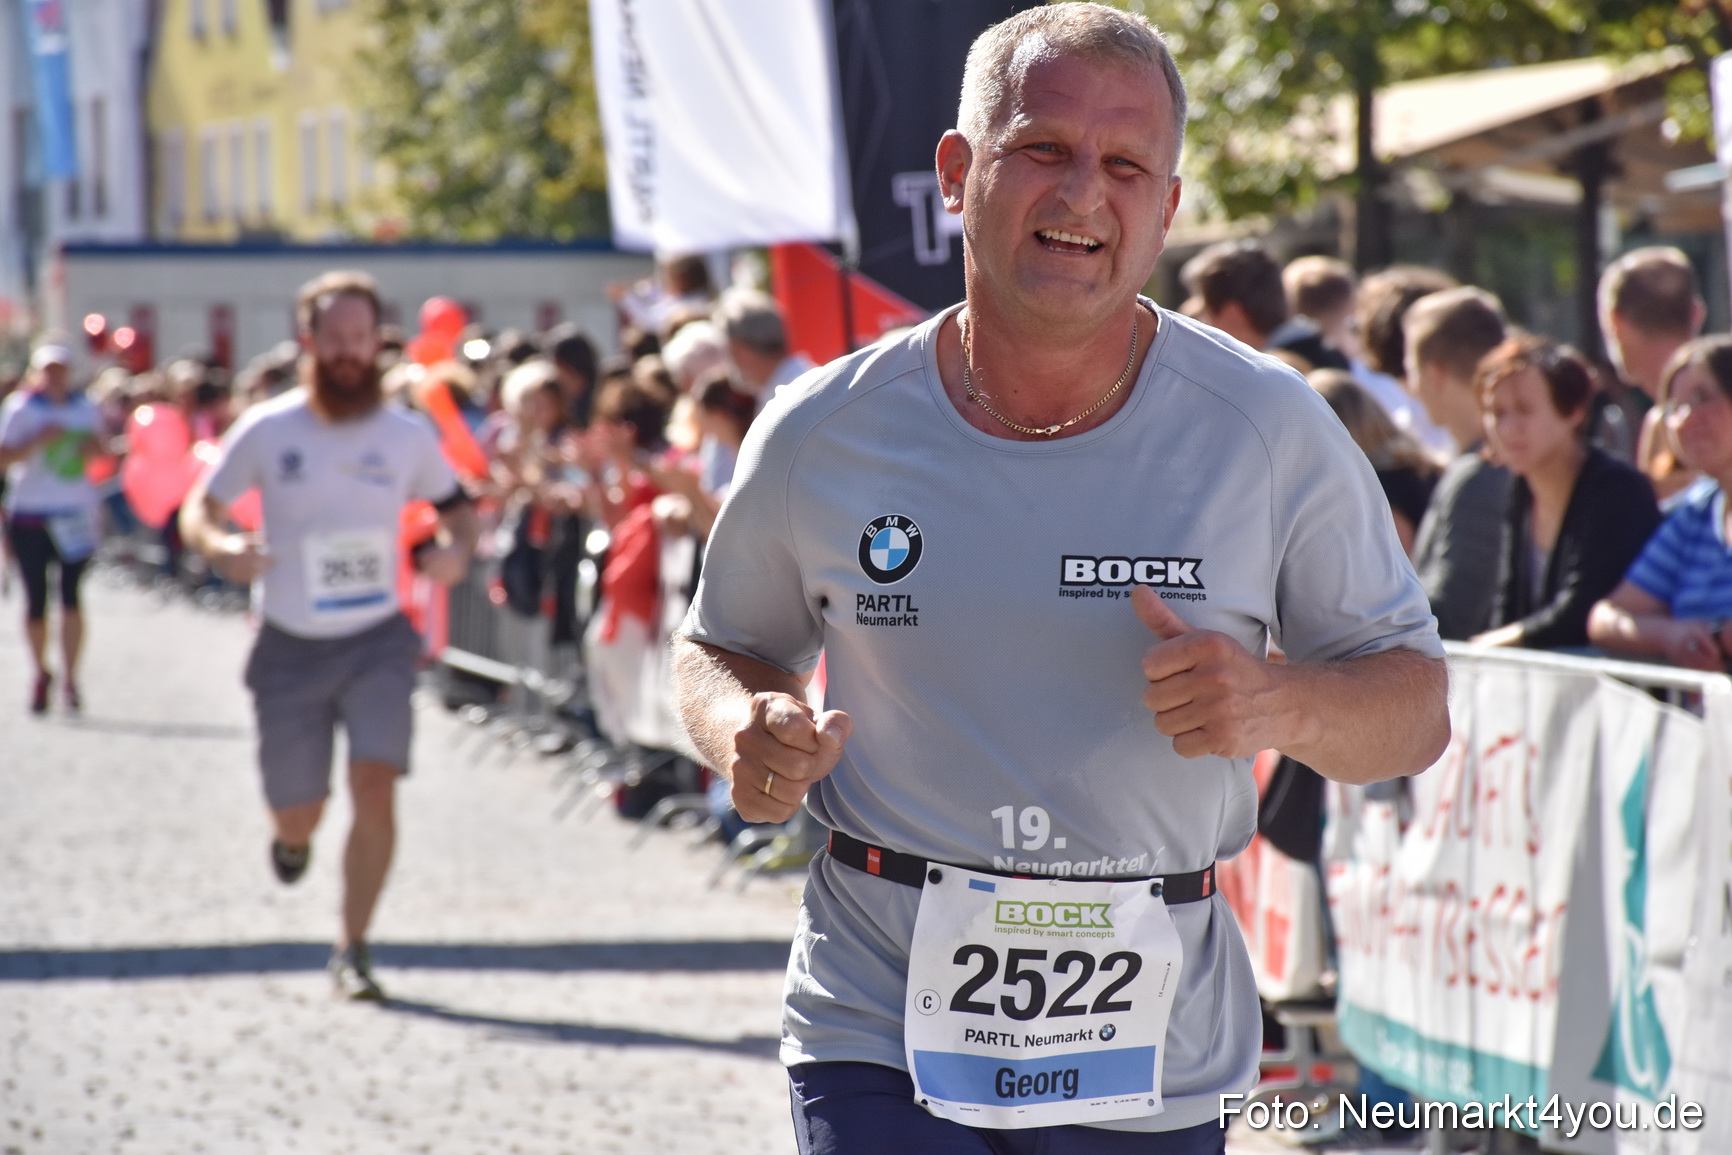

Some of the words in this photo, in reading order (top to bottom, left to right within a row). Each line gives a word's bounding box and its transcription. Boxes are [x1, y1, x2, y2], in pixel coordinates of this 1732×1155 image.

[865, 516, 919, 538] BMW
[1060, 555, 1205, 589] BOCK
[856, 593, 919, 612] PARTL
[1059, 587, 1103, 599] inspired
[1107, 588, 1120, 599] by
[1160, 590, 1207, 602] concepts
[856, 612, 918, 626] Neumarkt
[990, 805, 1066, 851] 19.
[993, 853, 1148, 876] Neumarkter
[995, 900, 1114, 928] BOCK
[994, 925, 1031, 936] inspired
[1033, 927, 1044, 937] by
[1046, 930, 1073, 938] smart
[1075, 930, 1115, 939] concepts
[949, 943, 1142, 1021] 2522
[964, 1028, 1020, 1047] PARTL
[1024, 1028, 1093, 1048] Neumarkt
[995, 1067, 1079, 1099] Georg
